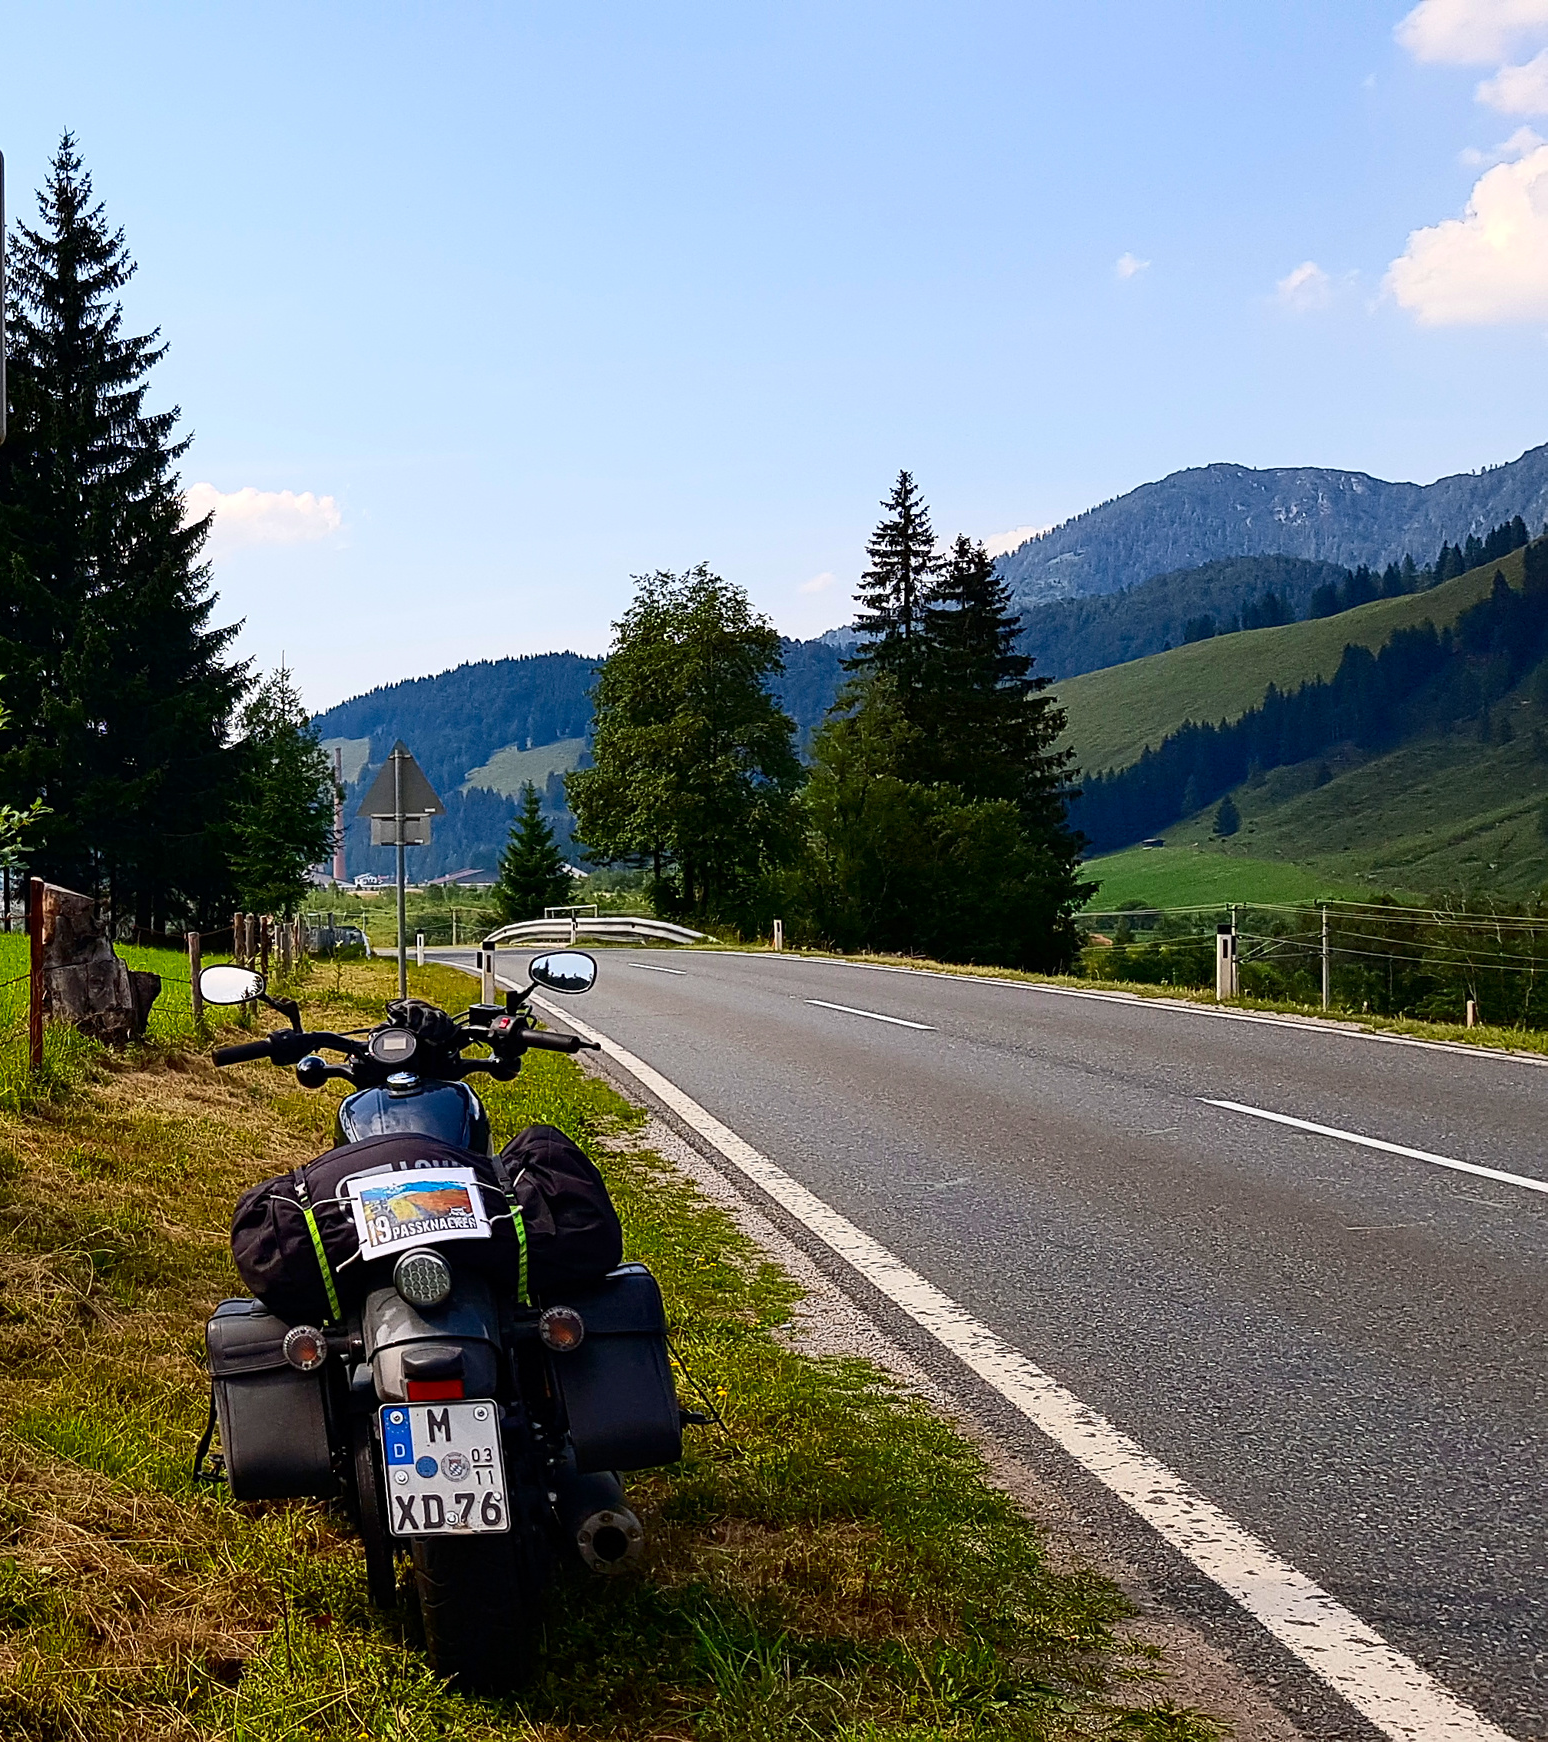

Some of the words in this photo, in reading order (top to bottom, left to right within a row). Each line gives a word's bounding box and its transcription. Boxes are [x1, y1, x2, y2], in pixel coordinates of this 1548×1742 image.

[367, 1216, 392, 1246] 19
[392, 1217, 477, 1239] PASSKNACKER
[427, 1408, 452, 1442] M
[394, 1444, 406, 1458] D
[471, 1448, 492, 1462] 03
[475, 1470, 494, 1485] 11
